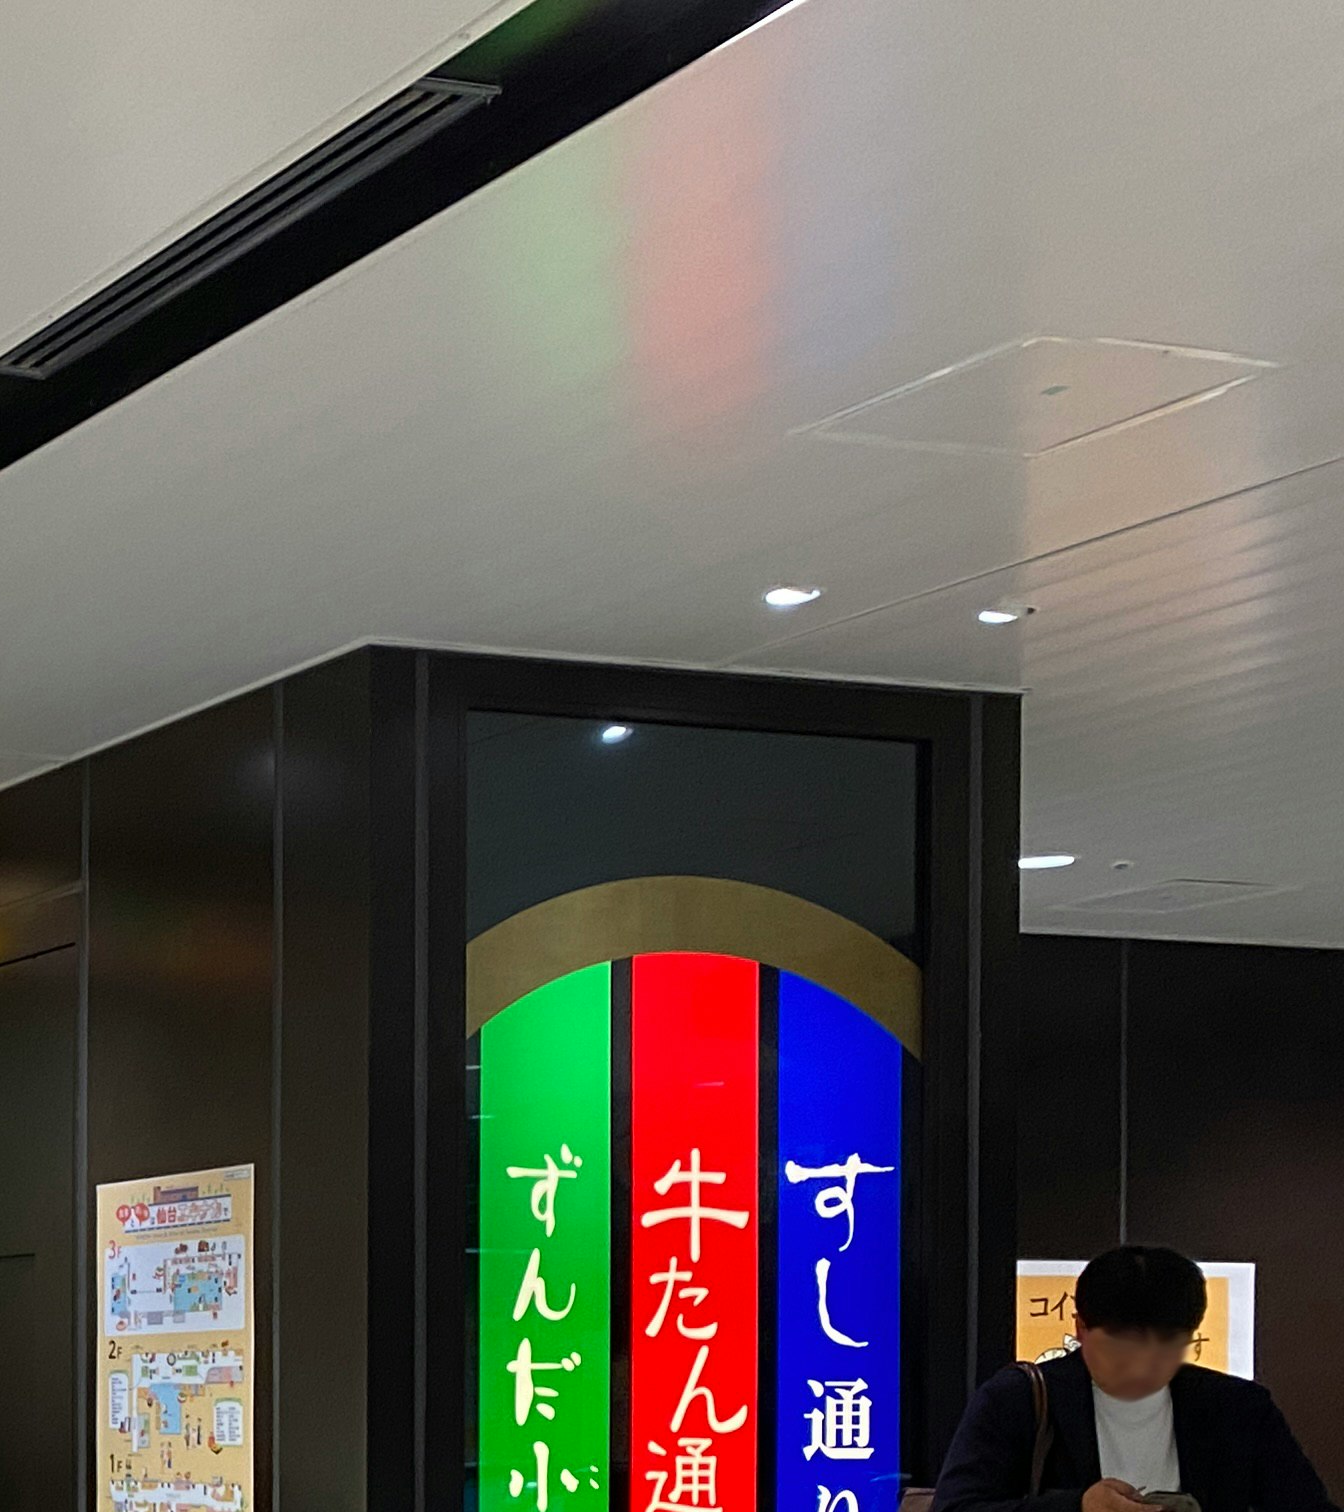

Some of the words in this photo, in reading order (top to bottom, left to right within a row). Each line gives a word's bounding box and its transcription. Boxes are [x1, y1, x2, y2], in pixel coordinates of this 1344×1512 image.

[1030, 1291, 1077, 1321] コイ
[108, 1340, 123, 1359] 2F
[110, 1454, 123, 1472] 1F
